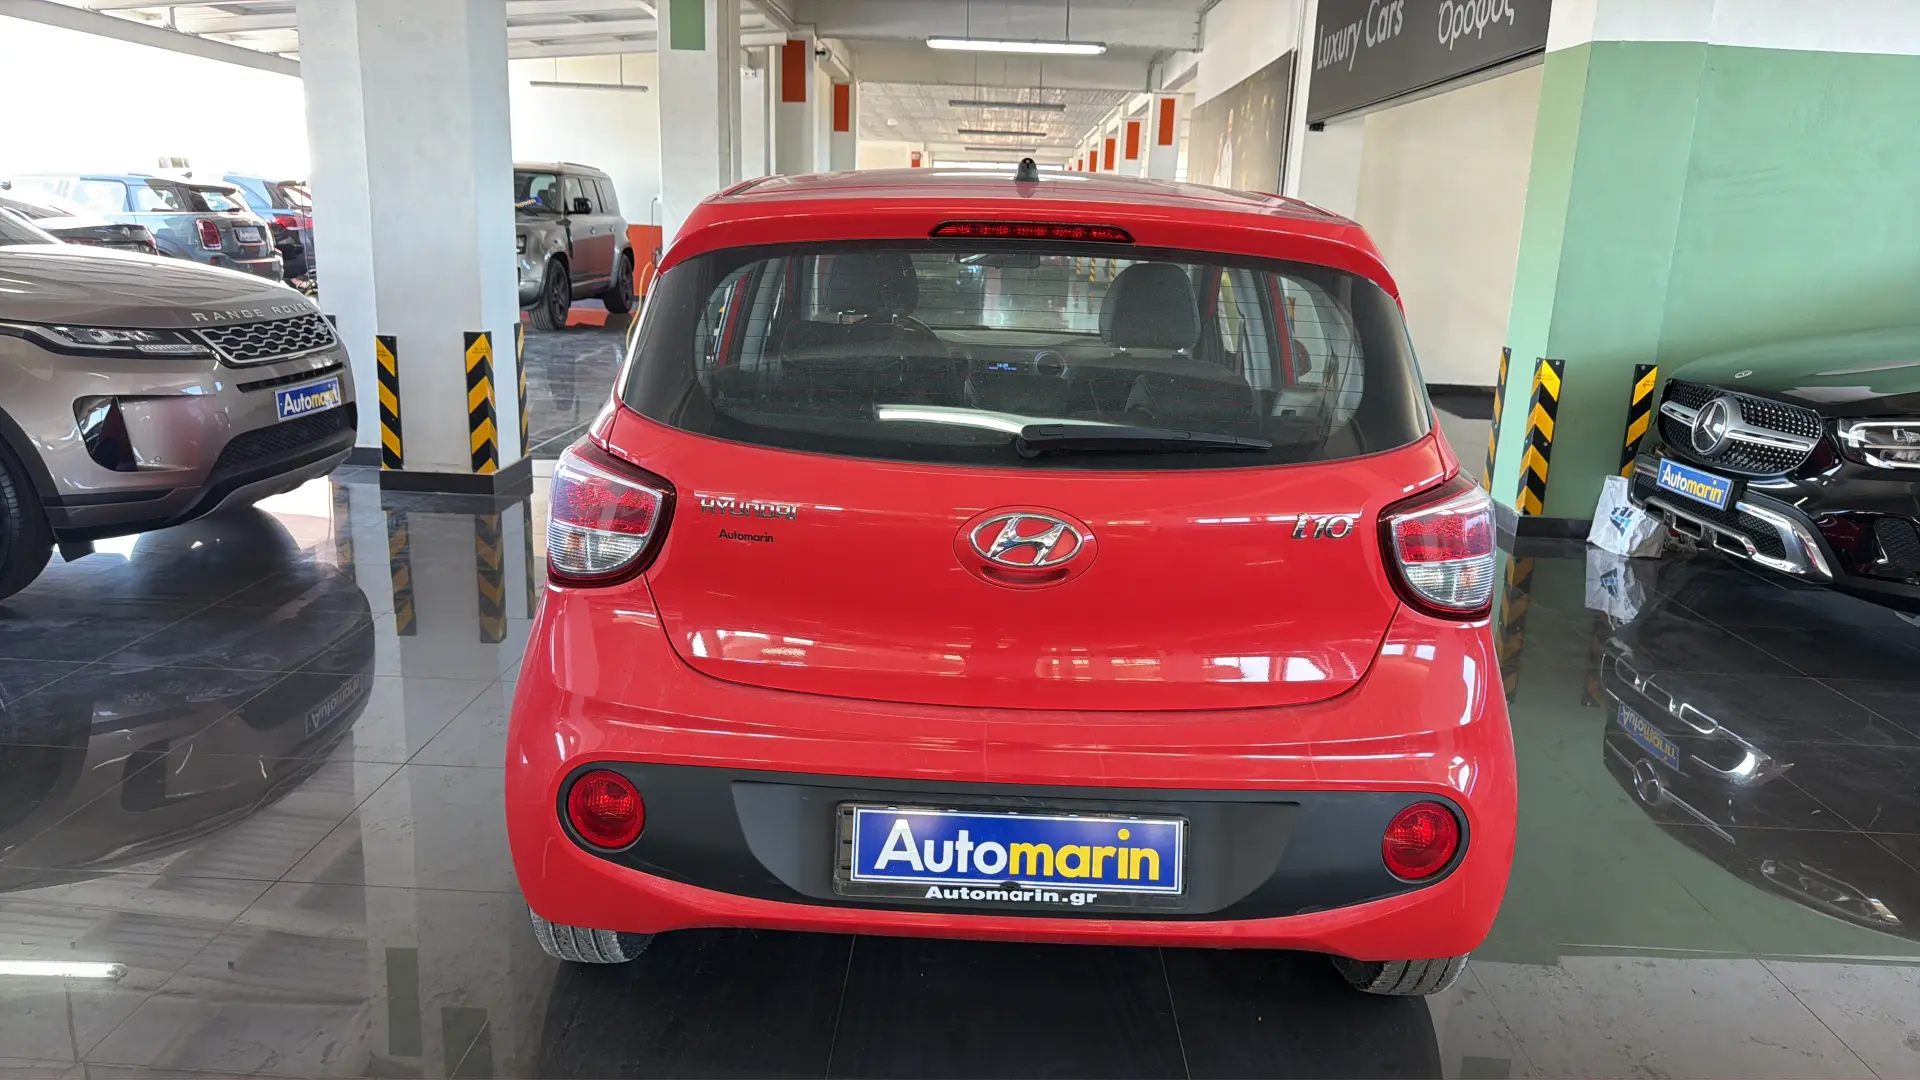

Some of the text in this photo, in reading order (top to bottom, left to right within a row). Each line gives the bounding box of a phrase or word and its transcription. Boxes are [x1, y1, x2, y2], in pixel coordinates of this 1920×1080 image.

[1317, 0, 1404, 71] Luxury Cars
[191, 301, 312, 322] RANGE ROVER
[1661, 463, 1723, 503] Automarin
[701, 498, 797, 520] HYUNDAI
[719, 528, 774, 543] Automarin
[1292, 513, 1354, 540] i10
[874, 818, 1160, 881] Automarin
[925, 885, 1098, 906] Automarin.gr
